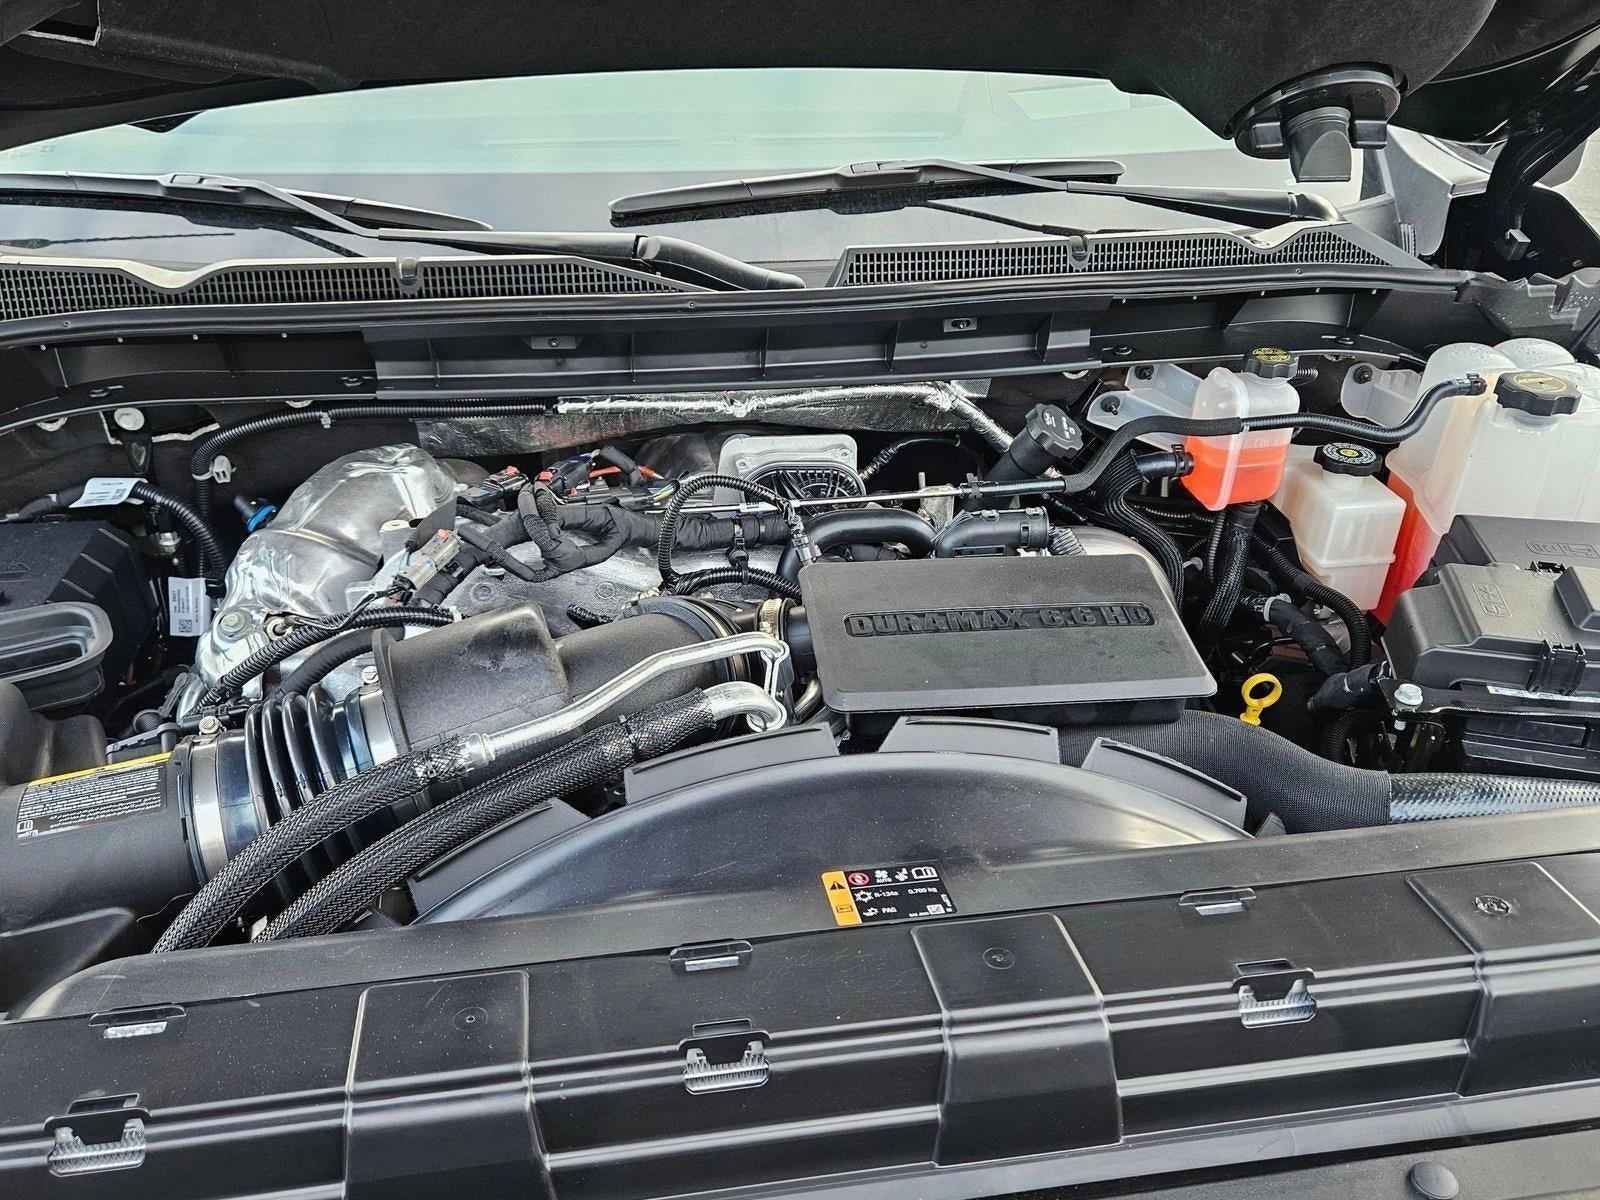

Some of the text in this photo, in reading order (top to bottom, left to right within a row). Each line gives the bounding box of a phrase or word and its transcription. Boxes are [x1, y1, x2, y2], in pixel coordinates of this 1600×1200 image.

[850, 605, 1149, 635] DURAMAX 6.6 HD
[874, 890, 899, 898] R-134a
